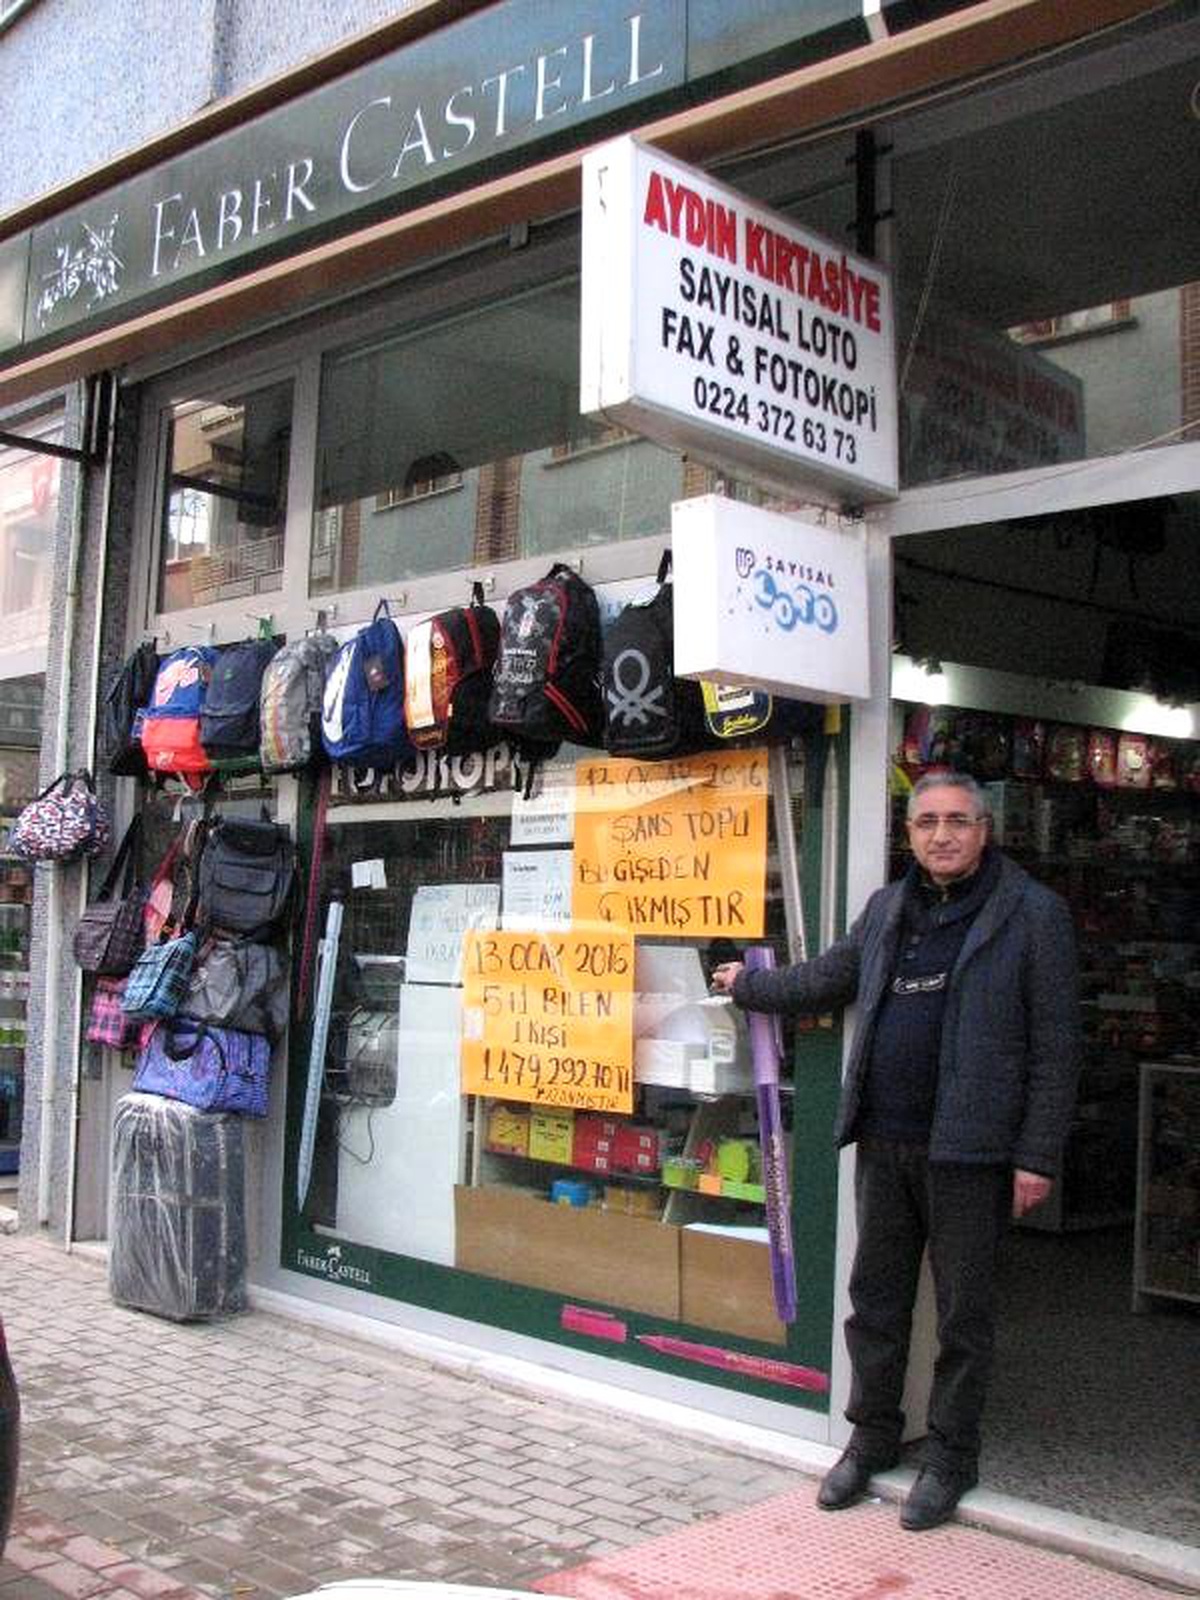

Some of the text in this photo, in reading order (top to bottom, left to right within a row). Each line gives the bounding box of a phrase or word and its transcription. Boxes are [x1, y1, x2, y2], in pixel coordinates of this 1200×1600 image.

[149, 15, 663, 277] FABER CASTELL
[643, 170, 881, 334] AYDIN KIRTASİYE
[679, 257, 858, 371] SAYISAL LOTO
[662, 307, 715, 367] FAX
[726, 335, 744, 377] &
[755, 346, 877, 432] FOTOKOPİ
[694, 376, 857, 465] 0224 372 63 73
[766, 555, 835, 588] SAYISAL
[682, 805, 750, 841] TOPU
[475, 941, 503, 975] 13
[575, 942, 629, 977] 2016
